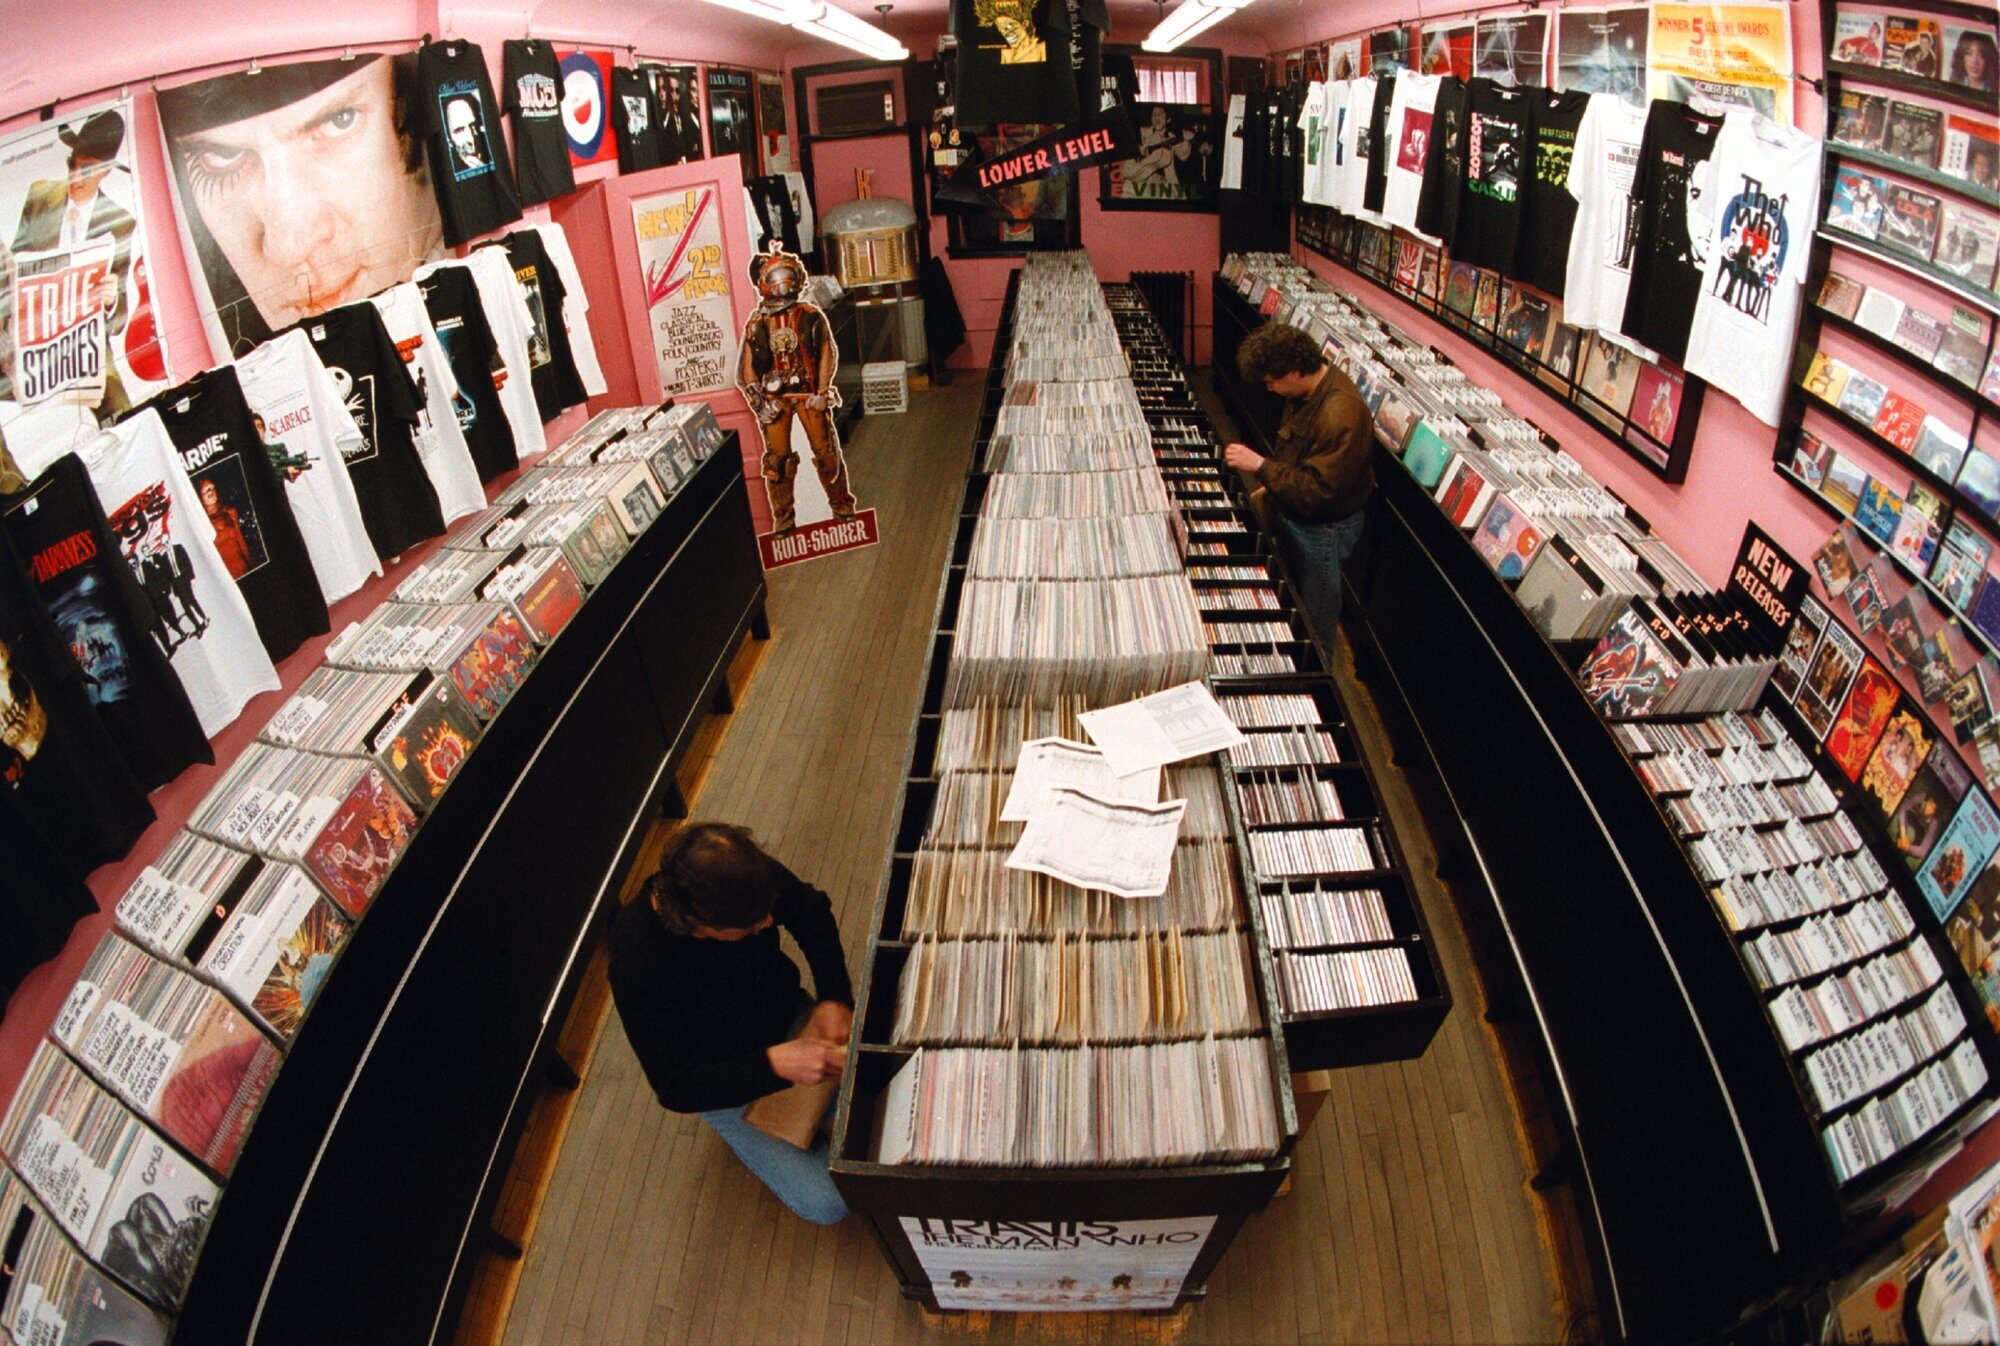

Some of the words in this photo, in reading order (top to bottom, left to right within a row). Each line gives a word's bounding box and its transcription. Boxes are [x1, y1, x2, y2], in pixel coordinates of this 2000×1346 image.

[1657, 18, 1690, 33] WINNER
[1690, 17, 1705, 45] 5
[1738, 22, 1769, 37] AWARDS
[1469, 112, 1482, 179] LONDON
[1539, 127, 1575, 140] KRAFTWERK
[979, 149, 1053, 188] LOWER
[1055, 129, 1115, 164] LEVEL
[1740, 173, 1779, 217] The
[638, 191, 696, 241] NEW!
[1734, 197, 1782, 246] Who
[516, 265, 537, 280] IVER
[684, 272, 729, 300] FLOOR
[22, 267, 99, 341] TRUE
[671, 305, 697, 318] JAZZ
[660, 316, 709, 331] CLASSICAL
[669, 330, 724, 348] SOUNDTRACKS
[23, 318, 99, 398] STORIES
[685, 373, 724, 392] T-SHIRTS
[269, 405, 312, 438] SCARFACE
[182, 432, 228, 473] ARRIE"
[33, 530, 97, 583] DARKNESS
[1748, 537, 1794, 592] NEW
[1735, 565, 1792, 629] RELEASES
[1648, 617, 1671, 641] A-D
[255, 809, 276, 833] DOORS
[161, 895, 179, 918] PURPLE
[211, 902, 228, 919] D
[215, 930, 246, 970] CREATION
[116, 1054, 138, 1082] LEONARD
[131, 1033, 150, 1056] COHEN
[916, 1216, 1118, 1237] TRAVIS
[921, 1231, 973, 1244] THE
[985, 1235, 1080, 1248] MAN
[1086, 1231, 1199, 1245] WHO
